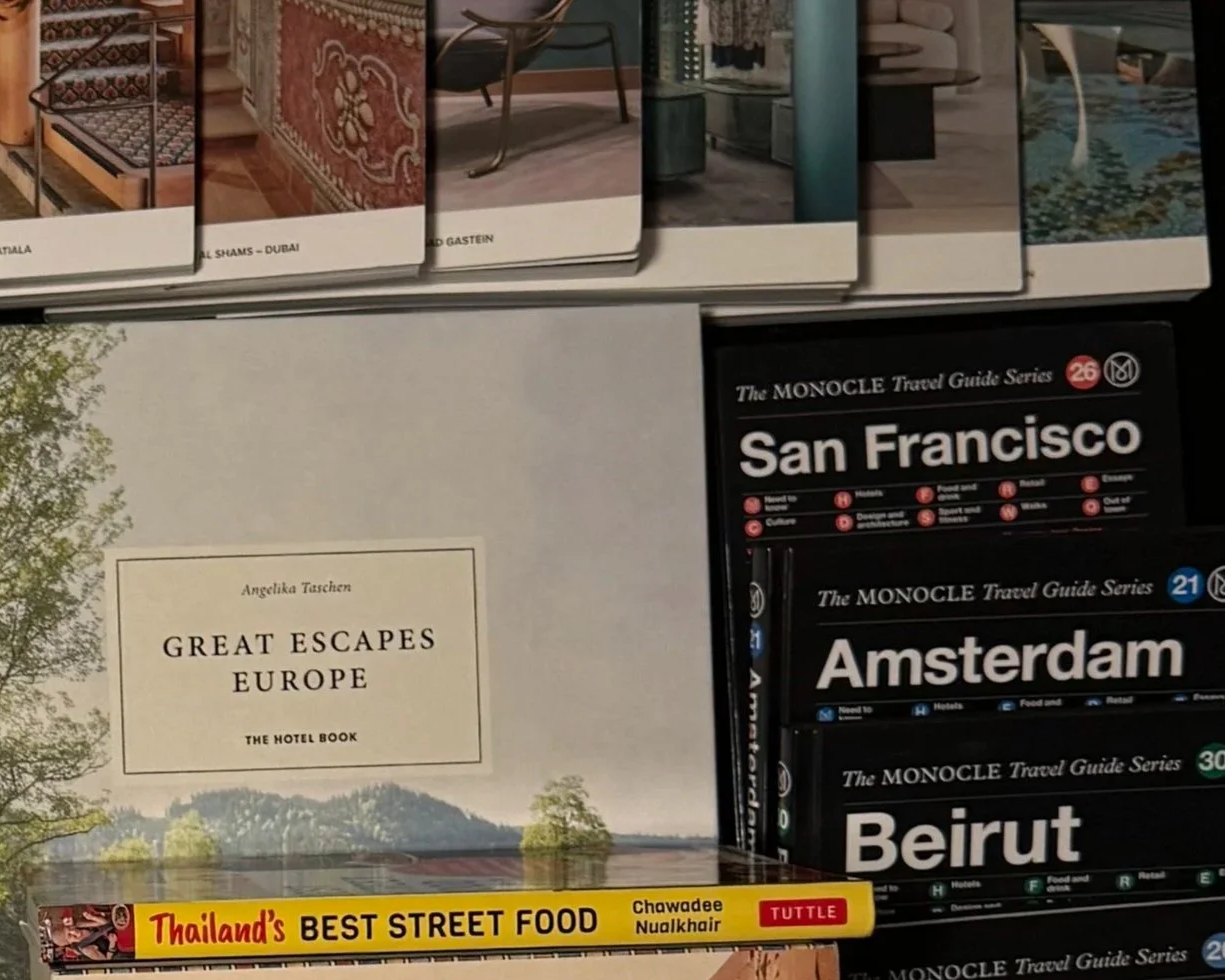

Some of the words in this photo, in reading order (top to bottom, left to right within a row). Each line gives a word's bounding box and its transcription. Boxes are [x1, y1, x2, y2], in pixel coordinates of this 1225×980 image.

[215, 247, 253, 259] SHAMS
[265, 243, 300, 255] DUBAI
[446, 234, 494, 247] GASTEIN
[735, 385, 767, 403] The
[772, 376, 885, 400] MONOCLE
[892, 374, 946, 393] Travel
[948, 370, 999, 390] Guide
[1004, 367, 1054, 385] Series
[1069, 362, 1099, 382] 26
[739, 431, 847, 478] San
[866, 414, 1143, 469] Francisco
[241, 581, 297, 599] Angelika
[301, 580, 352, 596] Taschen
[817, 590, 851, 608] The
[856, 585, 976, 606] MONOCLE
[983, 583, 1038, 602] Travel
[1042, 580, 1097, 600] Guide
[1102, 578, 1154, 597] Series
[1172, 573, 1201, 596] 21
[162, 632, 275, 659] GREAT
[290, 627, 437, 655] ESCAPES
[816, 629, 1185, 690] Amsterdam
[232, 667, 368, 694] EUROPE
[245, 734, 270, 746] THE
[273, 733, 315, 745] HOTEL
[319, 731, 358, 743] BOOK
[842, 769, 877, 788] The
[882, 763, 1002, 786] MONOCLE
[1009, 759, 1065, 780] Travel
[1069, 757, 1123, 776] Guide
[1128, 754, 1183, 773] Series
[844, 805, 1082, 873] Beirut
[632, 898, 723, 916] Chawadee
[770, 904, 837, 922] TUTTLE
[149, 909, 285, 946] Thailand's
[300, 912, 378, 942] BEST
[388, 909, 504, 939] STREET
[516, 907, 598, 937] FOOD
[635, 917, 722, 935] Nualkhair
